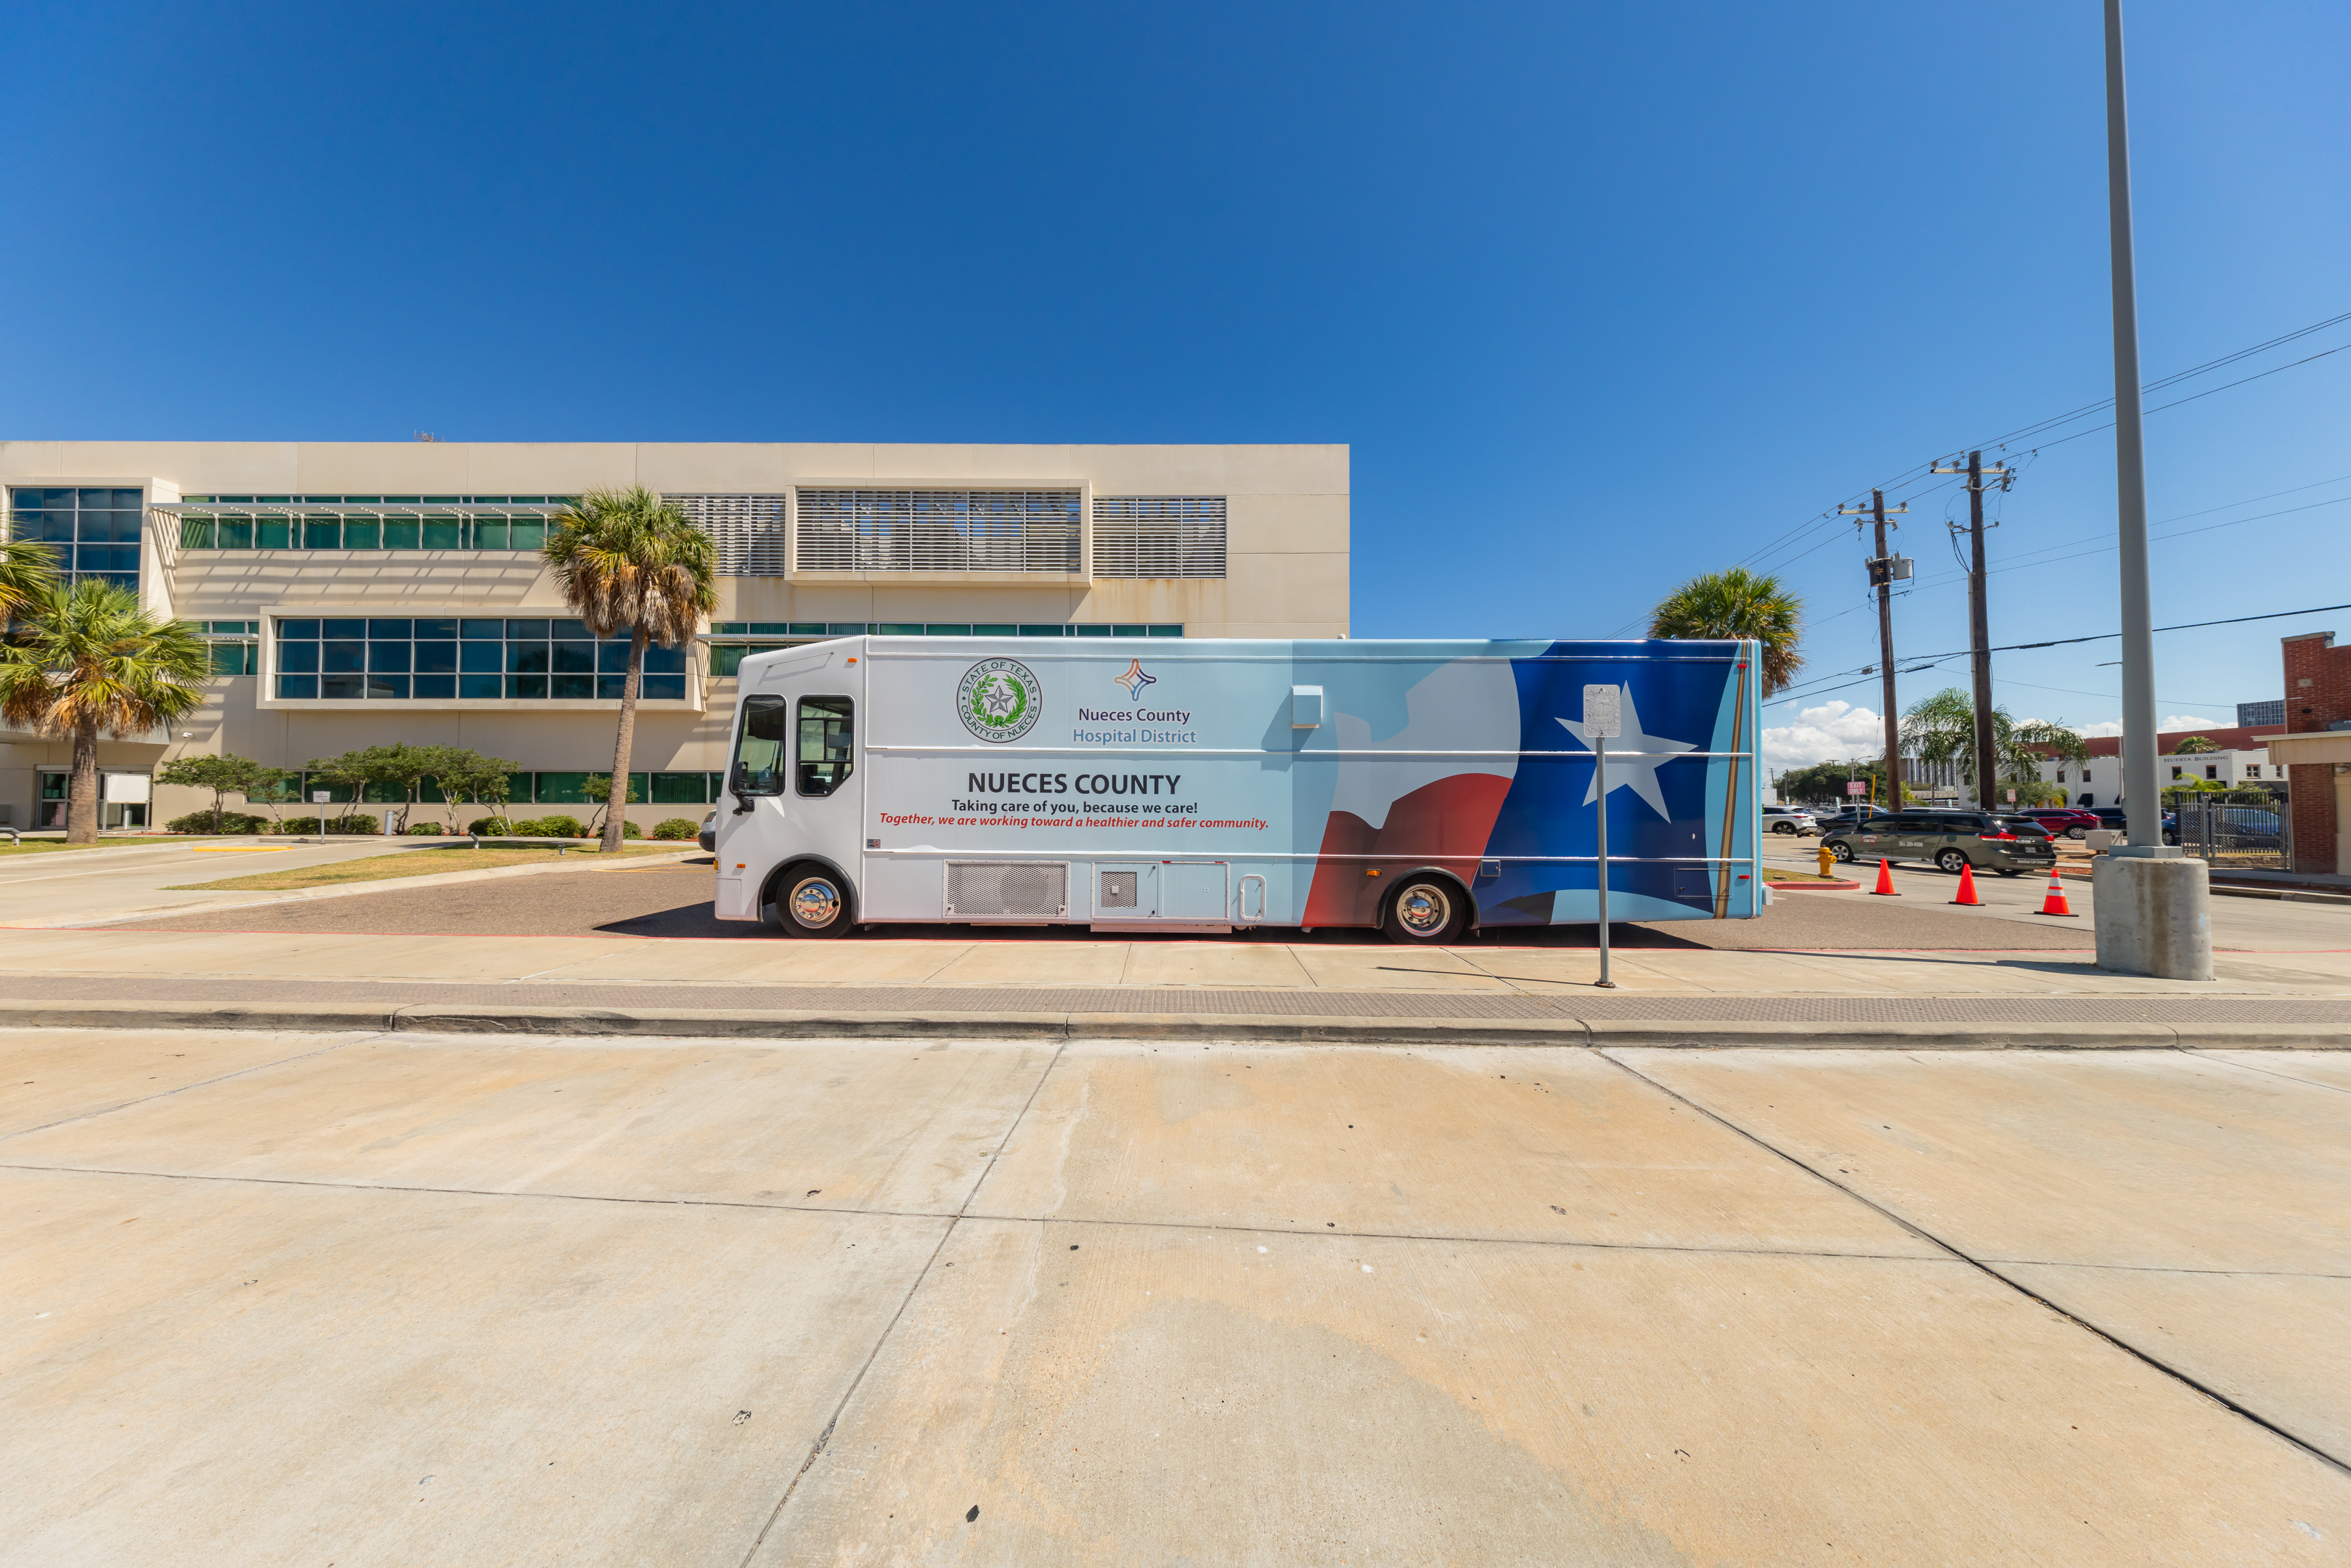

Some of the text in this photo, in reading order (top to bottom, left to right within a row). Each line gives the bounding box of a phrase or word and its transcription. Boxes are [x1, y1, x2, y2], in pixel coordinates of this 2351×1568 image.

[962, 664, 988, 693] STATE
[1010, 663, 1037, 693] TEXAS
[961, 705, 991, 737] COUNTY
[1008, 706, 1037, 738] NUECES
[1079, 709, 1190, 725] Nueces County
[1073, 729, 1196, 745] Hospital District
[968, 772, 1181, 794] NUECES COUNTY
[952, 799, 1198, 815] Taking care of you, because we care!
[880, 812, 935, 826] Together,
[957, 817, 977, 825] are
[980, 815, 1028, 828] working
[1031, 816, 1073, 827] toward
[1085, 817, 1139, 828] healthier
[1141, 817, 1165, 828] and
[1167, 817, 1197, 828] safer
[1199, 817, 1268, 830] community.
